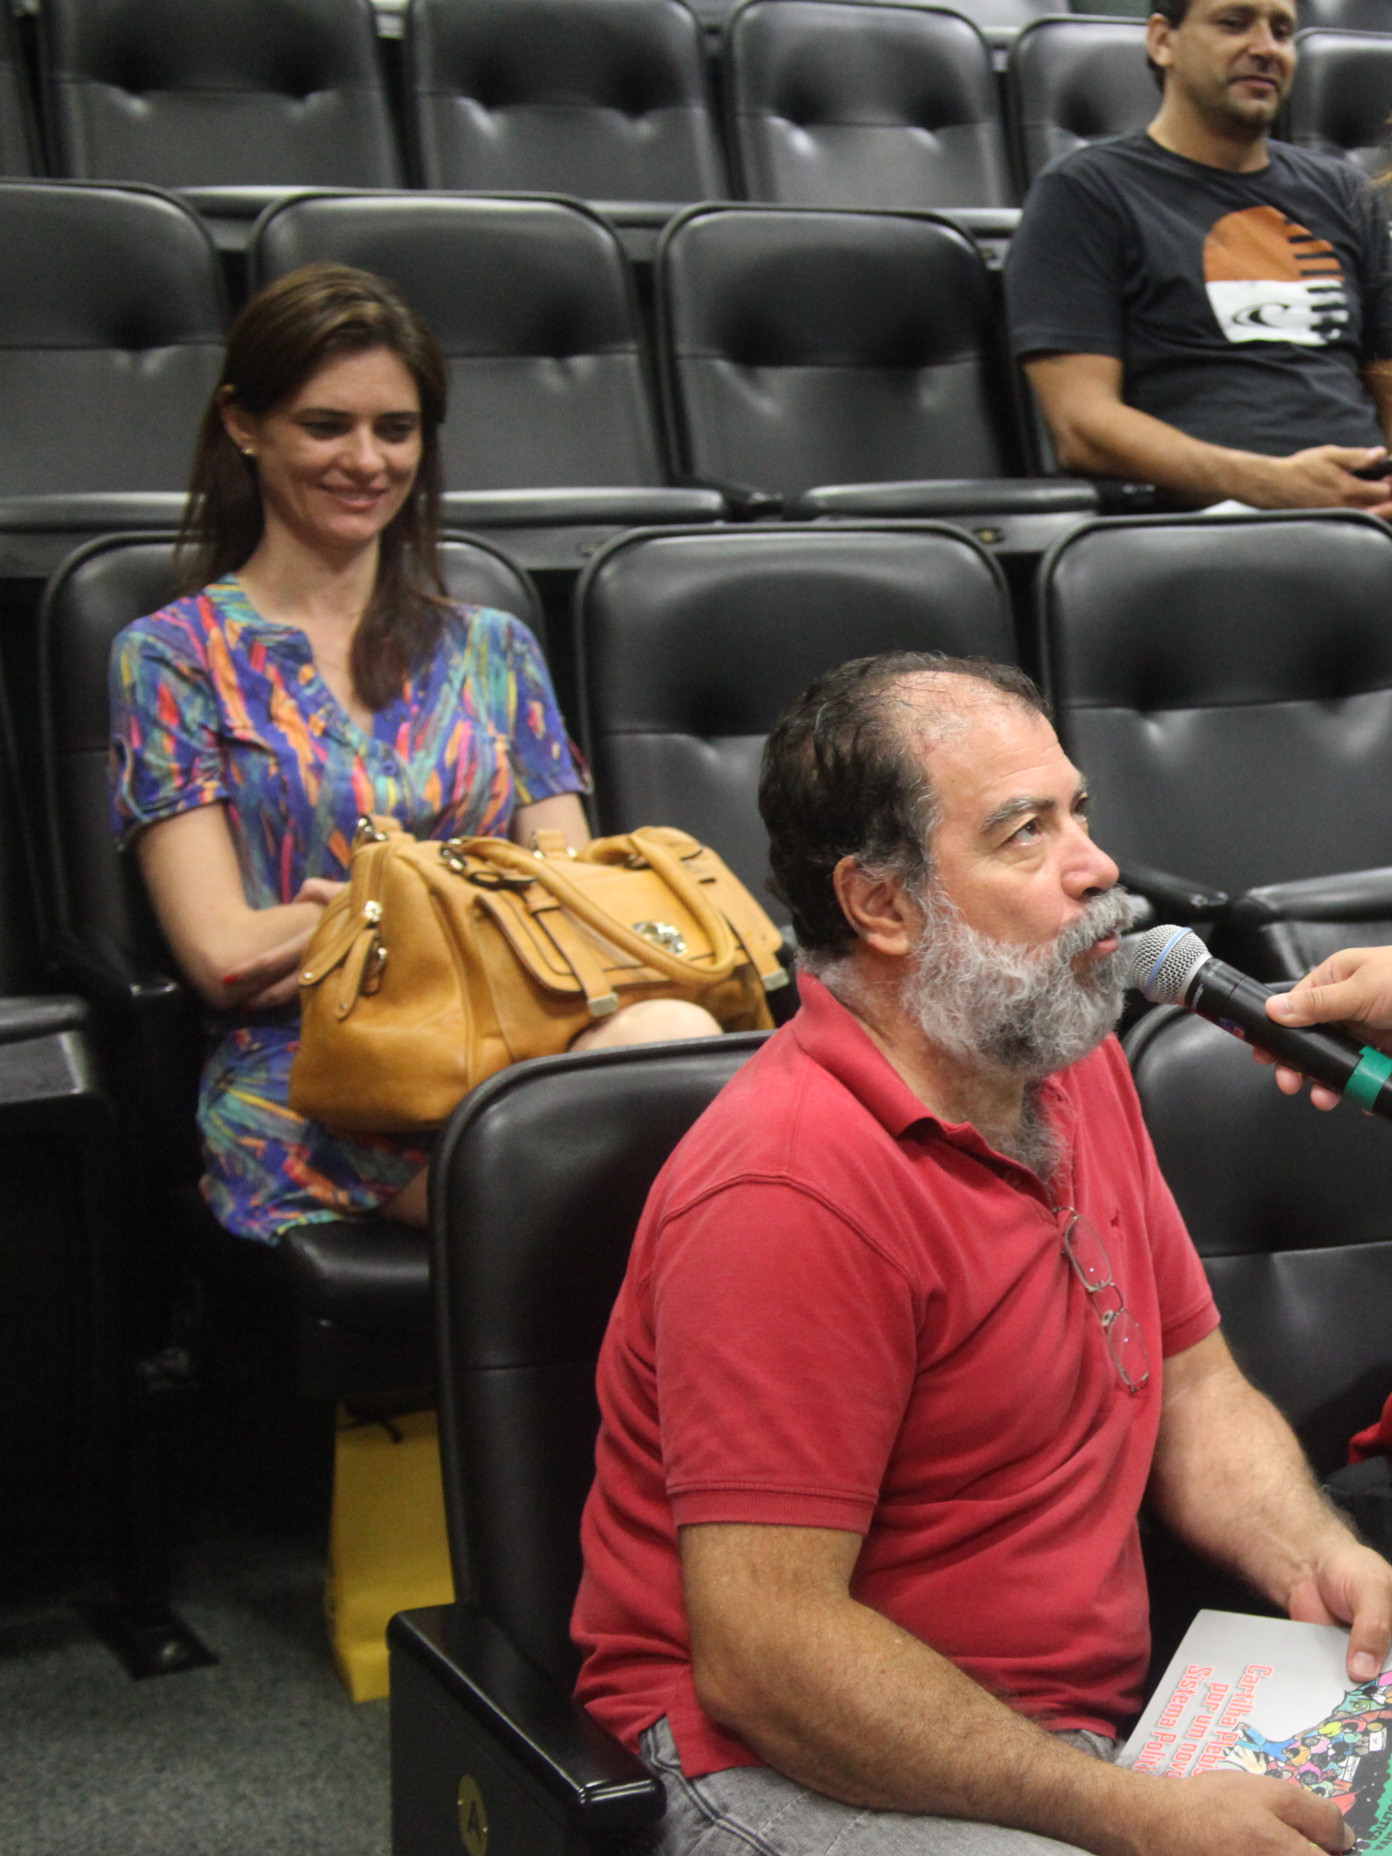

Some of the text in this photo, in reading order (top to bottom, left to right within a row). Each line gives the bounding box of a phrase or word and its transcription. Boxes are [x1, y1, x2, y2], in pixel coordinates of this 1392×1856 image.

[1157, 1663, 1215, 1728] Sistema
[1201, 1681, 1231, 1712] por
[1219, 1663, 1274, 1728] Cartilha
[1185, 1713, 1214, 1739] um
